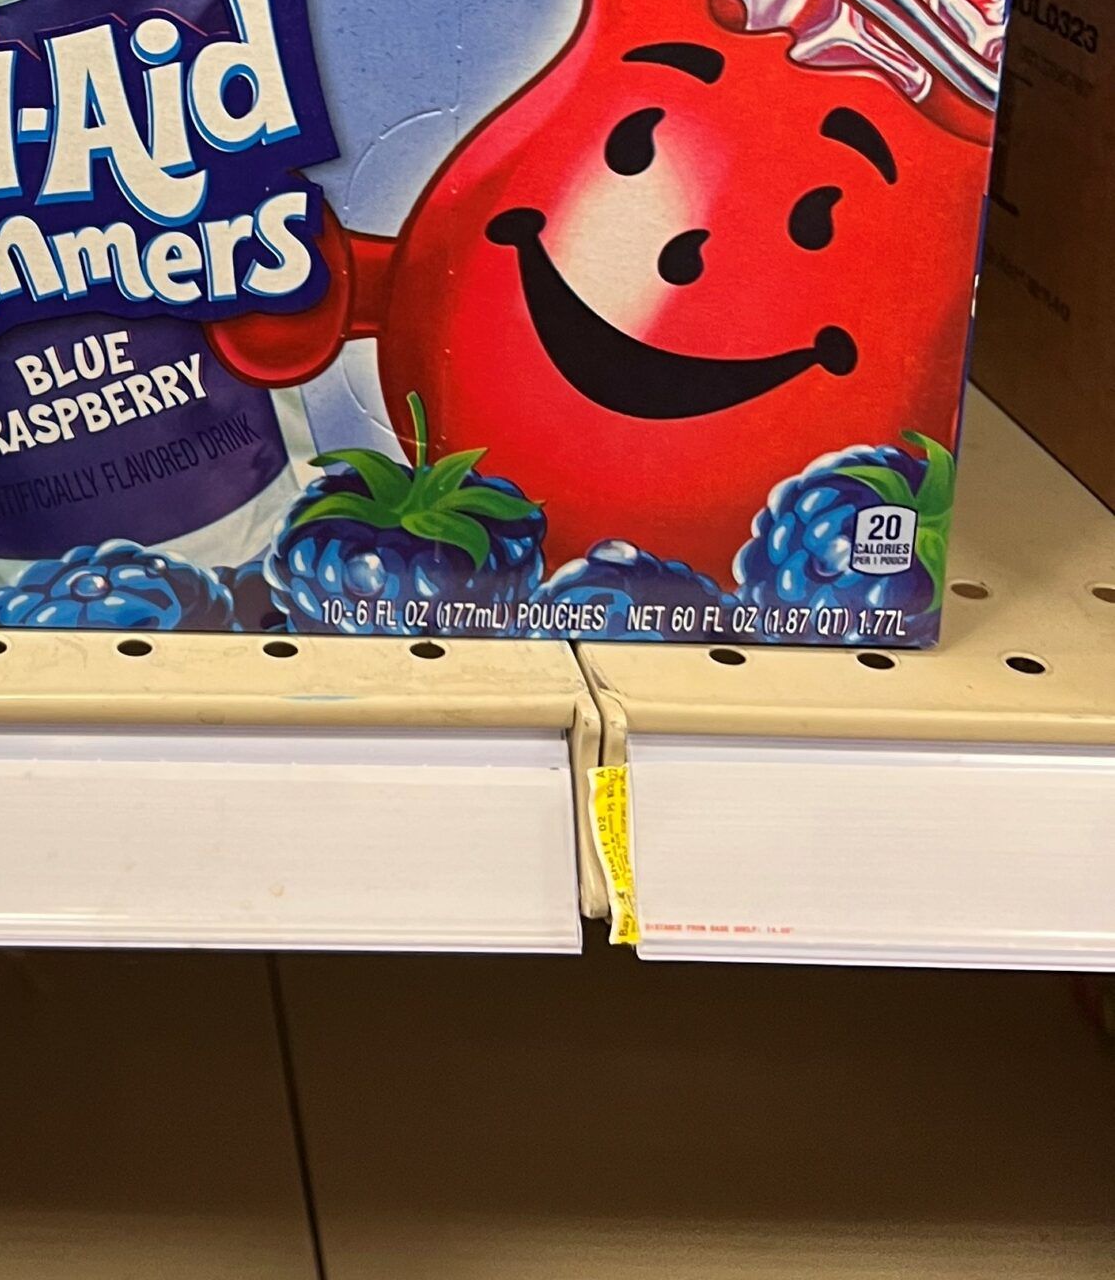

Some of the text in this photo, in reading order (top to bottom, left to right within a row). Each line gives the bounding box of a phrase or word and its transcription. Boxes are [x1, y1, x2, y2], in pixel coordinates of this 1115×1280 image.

[15, 331, 134, 396] BLUE
[100, 438, 199, 493] FLAVORED
[198, 413, 261, 461] DRINK
[868, 515, 901, 540] 20
[855, 544, 910, 554] CALORIES
[376, 600, 396, 626] FL
[405, 601, 429, 627] OZ
[436, 602, 510, 629] (177mL)
[517, 603, 607, 631] POUCHES
[627, 606, 905, 636] NET 60 FL OZ (1.87 QT) 1.77L
